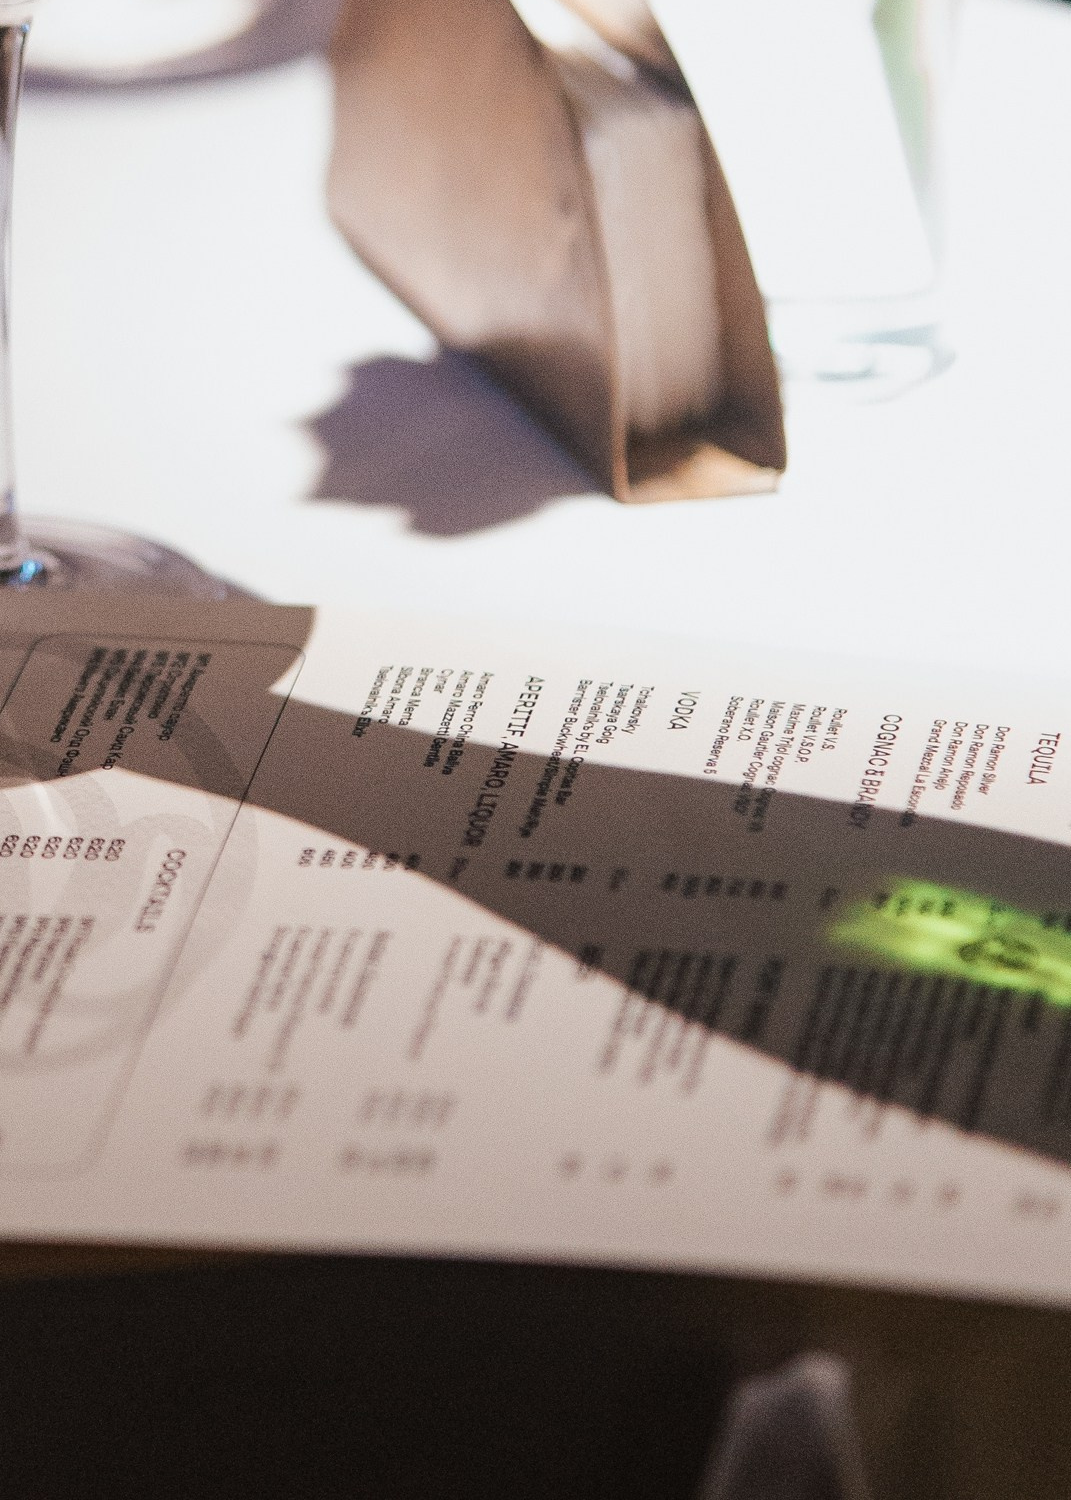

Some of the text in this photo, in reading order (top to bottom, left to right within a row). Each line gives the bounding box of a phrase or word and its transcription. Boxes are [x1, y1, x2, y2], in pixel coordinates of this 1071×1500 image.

[432, 668, 454, 693] Cynar
[451, 670, 473, 697] Amaro
[471, 671, 494, 698] Amaro
[377, 696, 400, 723] Amaro
[397, 667, 434, 725] Branca Menta
[567, 679, 593, 715] Barrister
[605, 684, 634, 722] Tsarskaya
[620, 686, 655, 734] Tchaikovsky
[668, 691, 701, 729] VODKA
[436, 700, 462, 735] Mazzetti
[462, 701, 483, 722] Ferro
[717, 696, 744, 733] Soberano
[763, 700, 785, 728] Maison
[66, 729, 91, 747] Олд
[451, 724, 473, 748] China
[574, 732, 594, 742] by
[736, 727, 753, 741] X.O.
[867, 714, 903, 766] COGNAC
[927, 719, 947, 743] Grand
[951, 721, 969, 736] Don
[705, 734, 730, 765] Reserva
[752, 730, 775, 759] Gautier
[764, 703, 806, 785] Maxime Trijol cognac
[795, 734, 815, 762] V.S.O.P.
[820, 737, 837, 751] V.S.
[917, 744, 939, 772] Mezcal
[942, 738, 963, 766] Ramon
[1027, 732, 1061, 784] TEQUILA
[97, 752, 123, 769] Кар
[461, 675, 543, 848] APERITIF, AMARO, LIQUOR
[949, 723, 990, 810] Don Ramon Reposado
[977, 726, 1011, 795] Don Ramon Silver
[914, 774, 925, 783] La
[849, 778, 881, 829] BRANDY
[18, 835, 41, 858] 620
[40, 836, 63, 859] 620
[61, 836, 84, 860] 620
[83, 837, 106, 861] 620
[103, 838, 126, 862] 620
[134, 849, 187, 933] COCKTAILS
